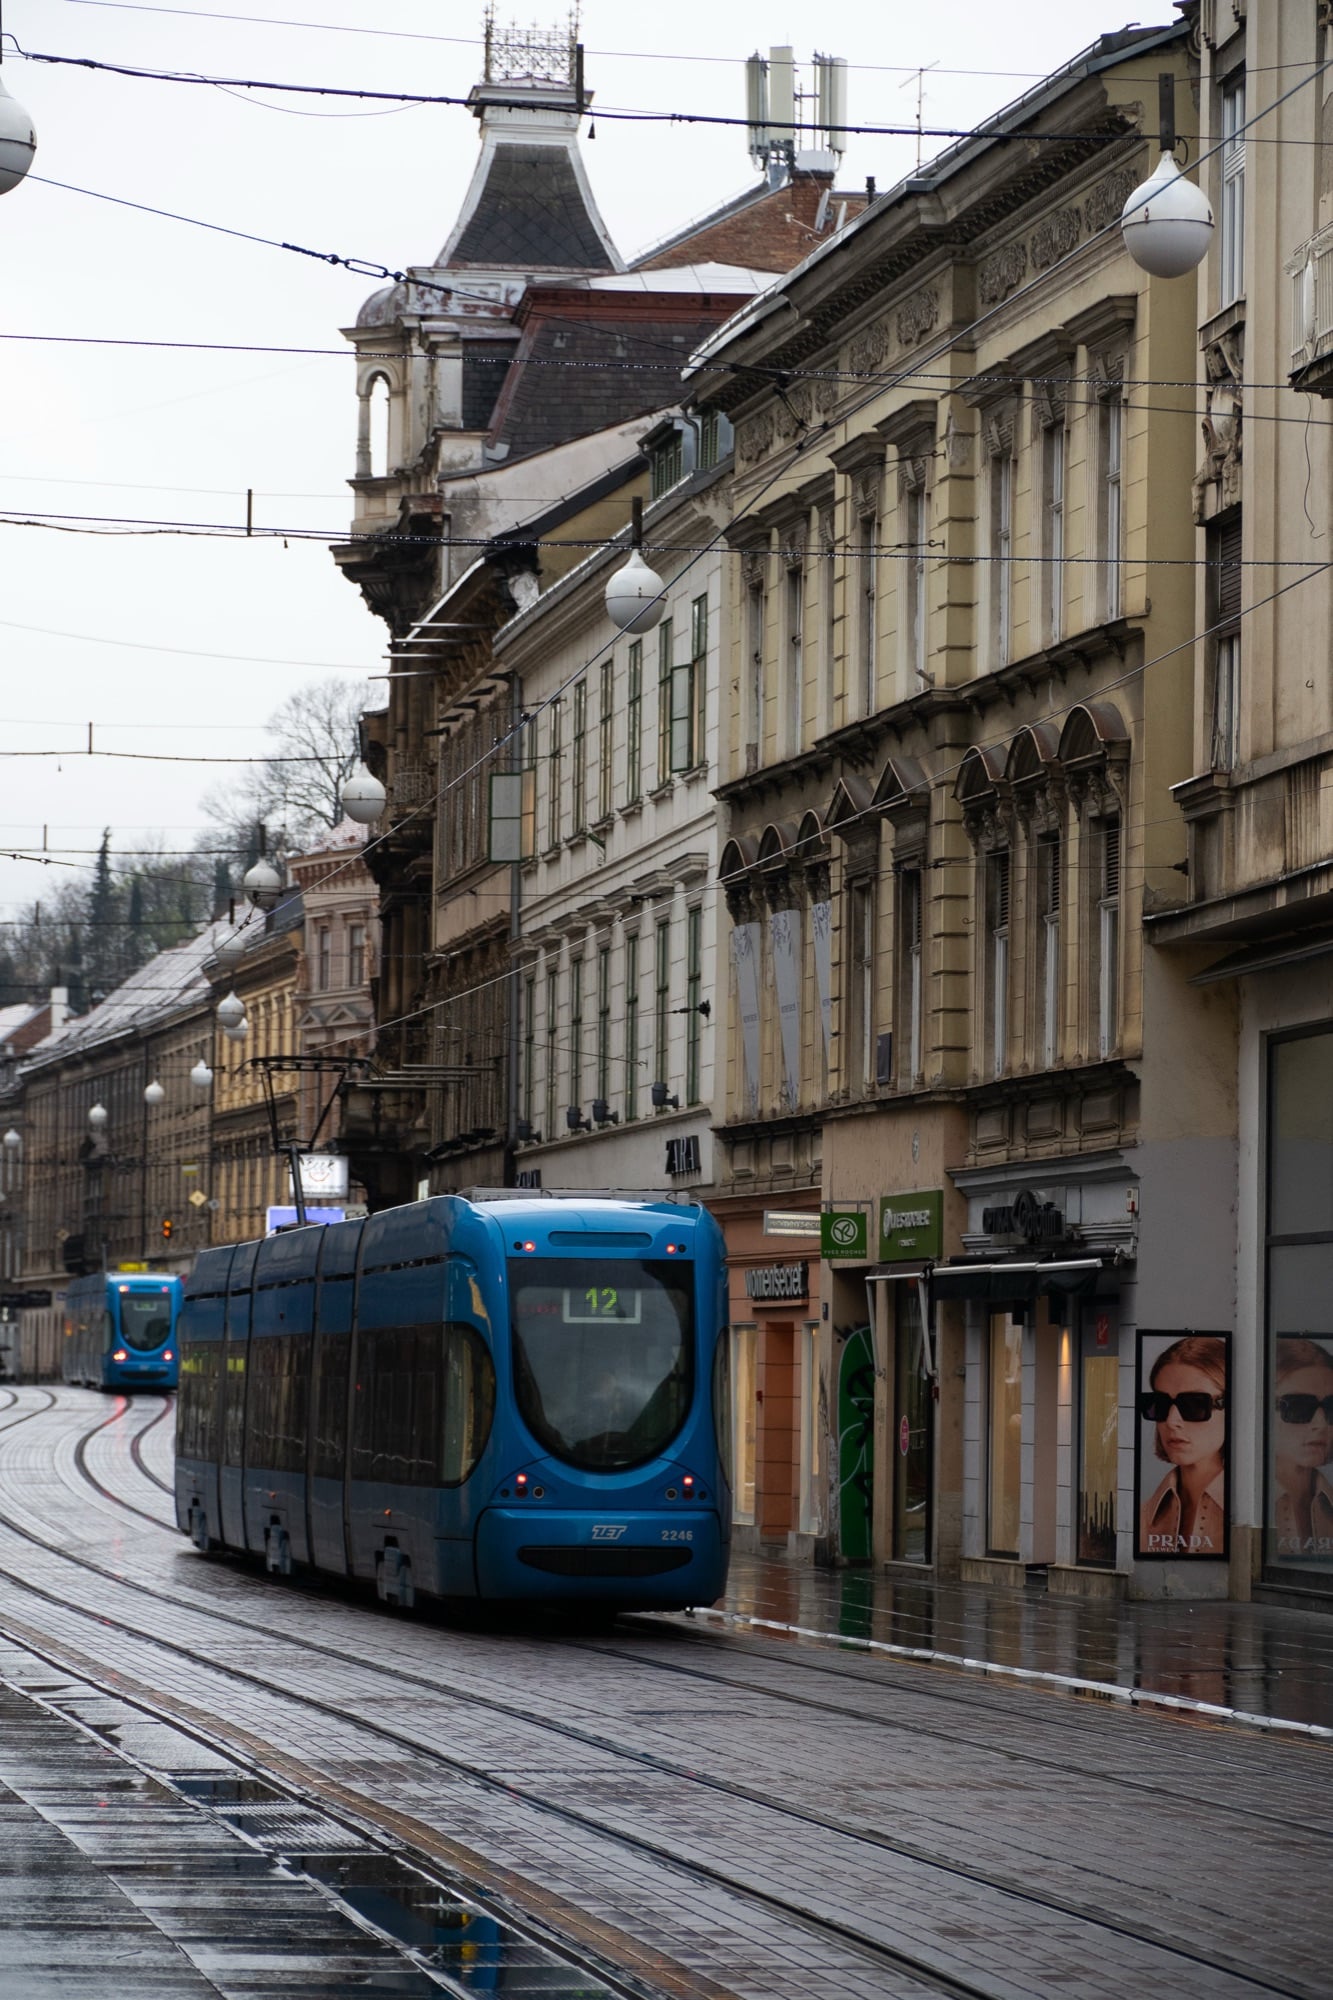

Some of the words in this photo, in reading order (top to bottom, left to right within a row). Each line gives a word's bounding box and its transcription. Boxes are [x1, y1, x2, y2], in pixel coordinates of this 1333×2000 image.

[665, 1136, 700, 1174] ZARA
[585, 1287, 618, 1315] 12
[592, 1525, 628, 1540] ZET
[661, 1530, 693, 1541] 2246
[1148, 1534, 1214, 1548] PRADA
